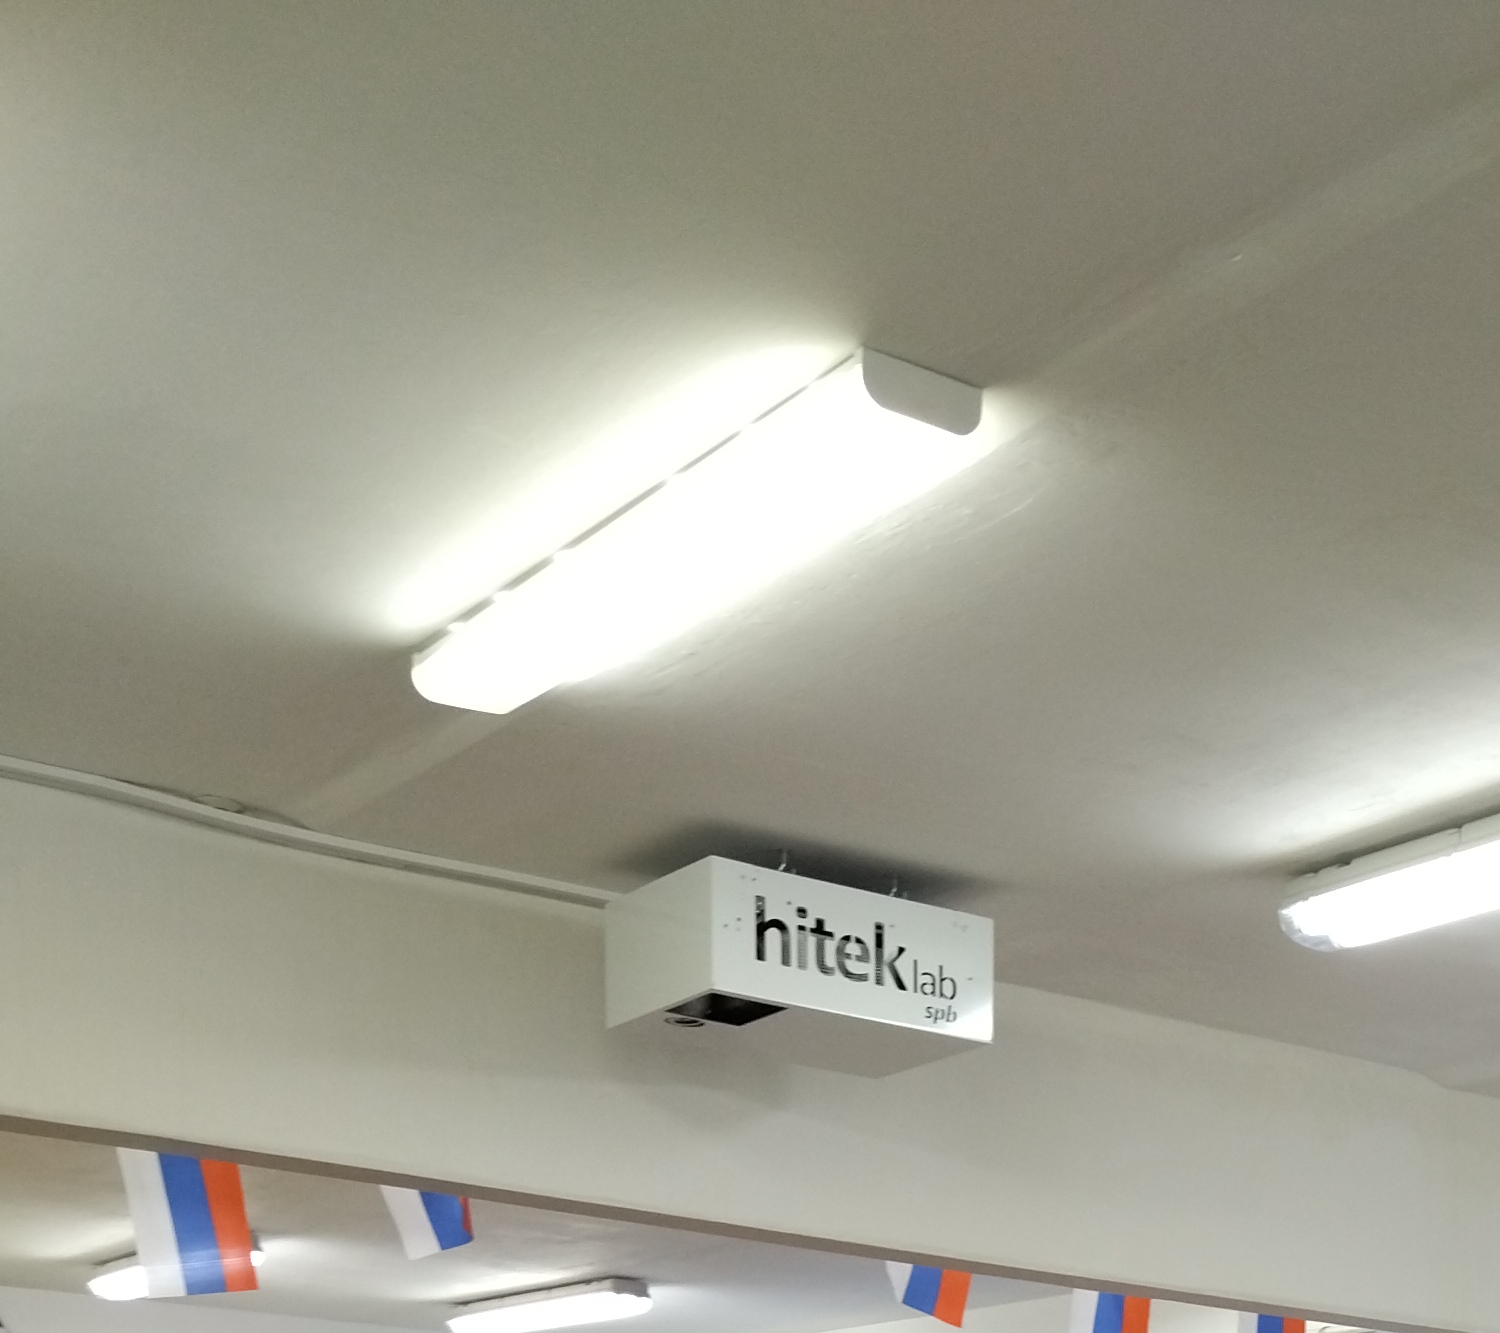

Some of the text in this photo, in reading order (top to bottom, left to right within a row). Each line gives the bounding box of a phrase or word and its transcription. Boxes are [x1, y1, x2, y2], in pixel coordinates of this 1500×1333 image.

[754, 895, 957, 1001] hitek lab
[924, 1004, 958, 1024] spb
